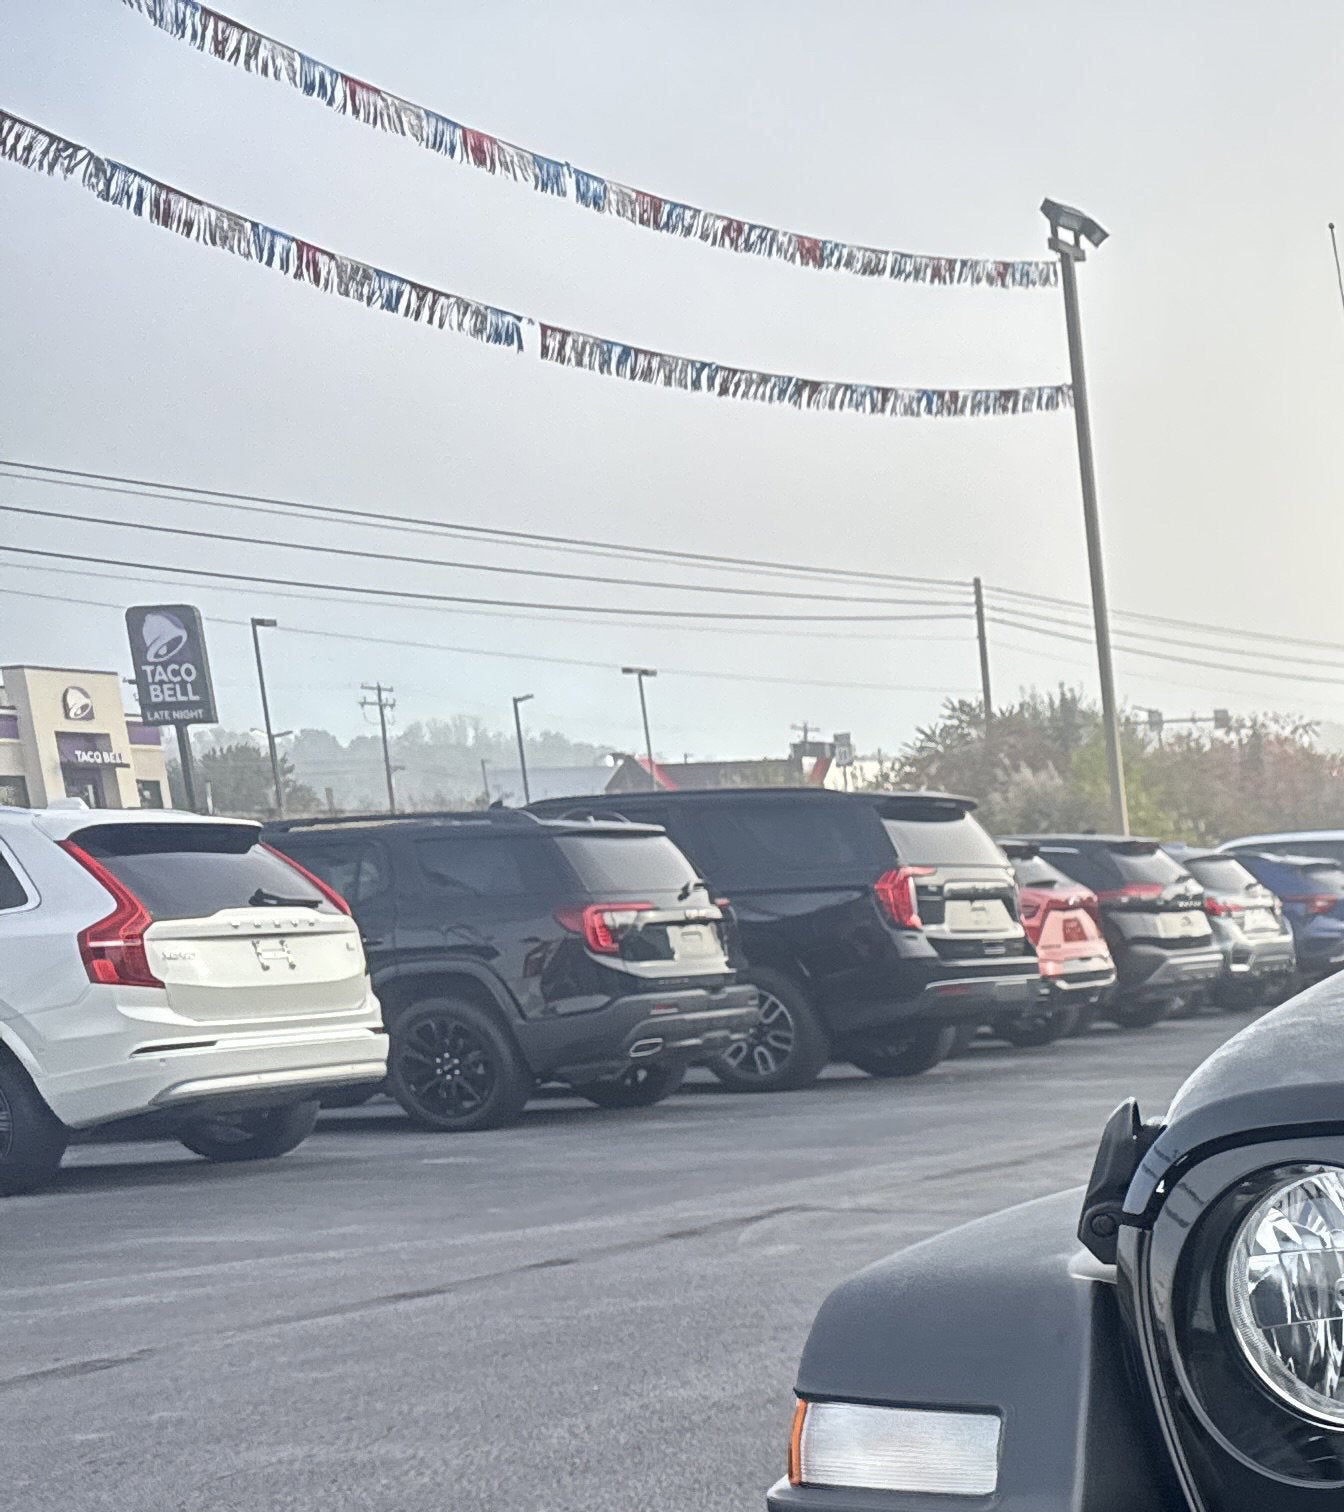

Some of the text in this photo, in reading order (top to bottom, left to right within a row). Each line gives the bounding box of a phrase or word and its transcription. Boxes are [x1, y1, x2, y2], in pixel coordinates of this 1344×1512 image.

[142, 663, 196, 682] TACO
[149, 683, 200, 702] BELL
[147, 709, 204, 720] LATE NIGHT
[74, 750, 102, 763] TACO
